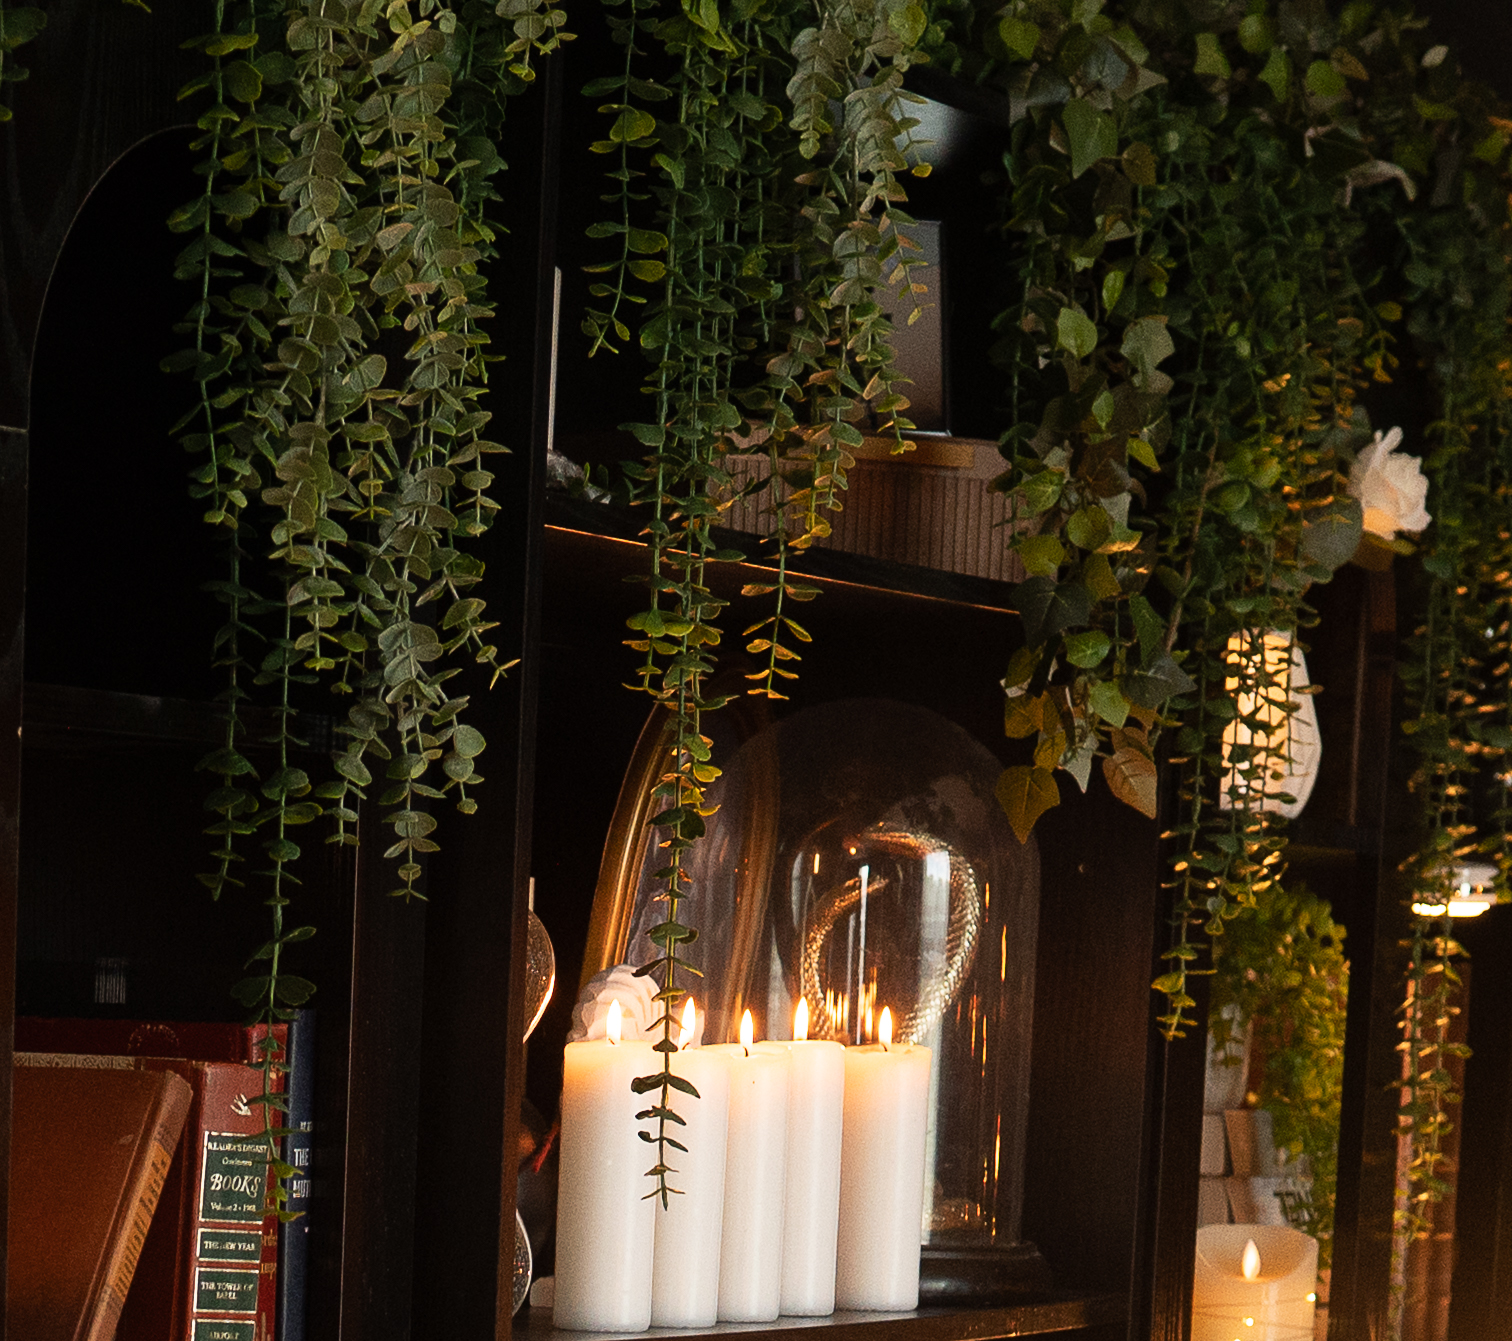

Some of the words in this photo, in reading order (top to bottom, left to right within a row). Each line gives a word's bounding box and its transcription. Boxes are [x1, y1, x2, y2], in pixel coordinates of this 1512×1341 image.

[210, 1173, 261, 1198] BOOKS
[203, 1241, 218, 1249] THE
[237, 1242, 255, 1251] YEAR
[201, 1282, 215, 1290] THE
[217, 1282, 241, 1291] TOWER
